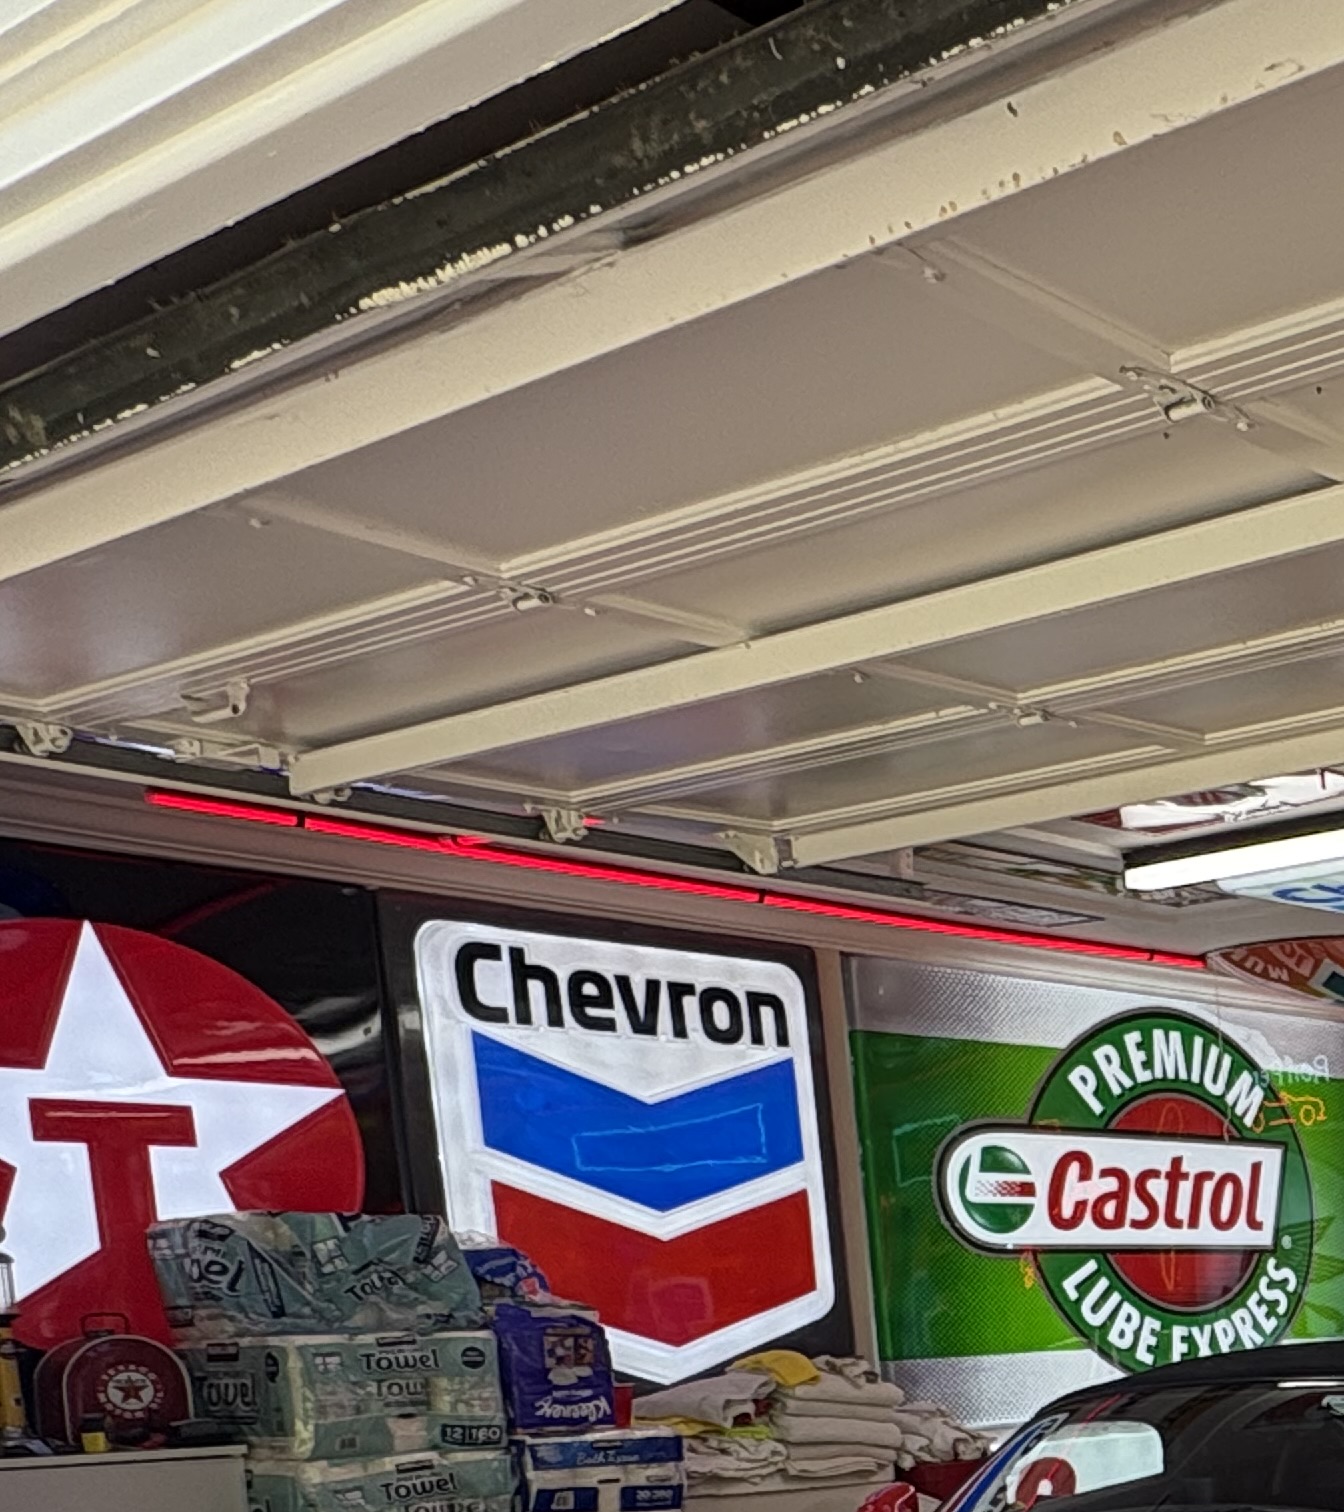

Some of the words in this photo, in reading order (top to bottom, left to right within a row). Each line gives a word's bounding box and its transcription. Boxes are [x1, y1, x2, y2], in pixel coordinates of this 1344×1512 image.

[454, 941, 790, 1049] Chevron
[1067, 1028, 1266, 1129] PREMIUM
[1046, 1149, 1265, 1234] Castrol
[1061, 1257, 1159, 1367] LUBE
[1171, 1256, 1299, 1363] EXPRESS
[361, 1349, 440, 1371] Towel
[380, 1472, 458, 1502] Towel
